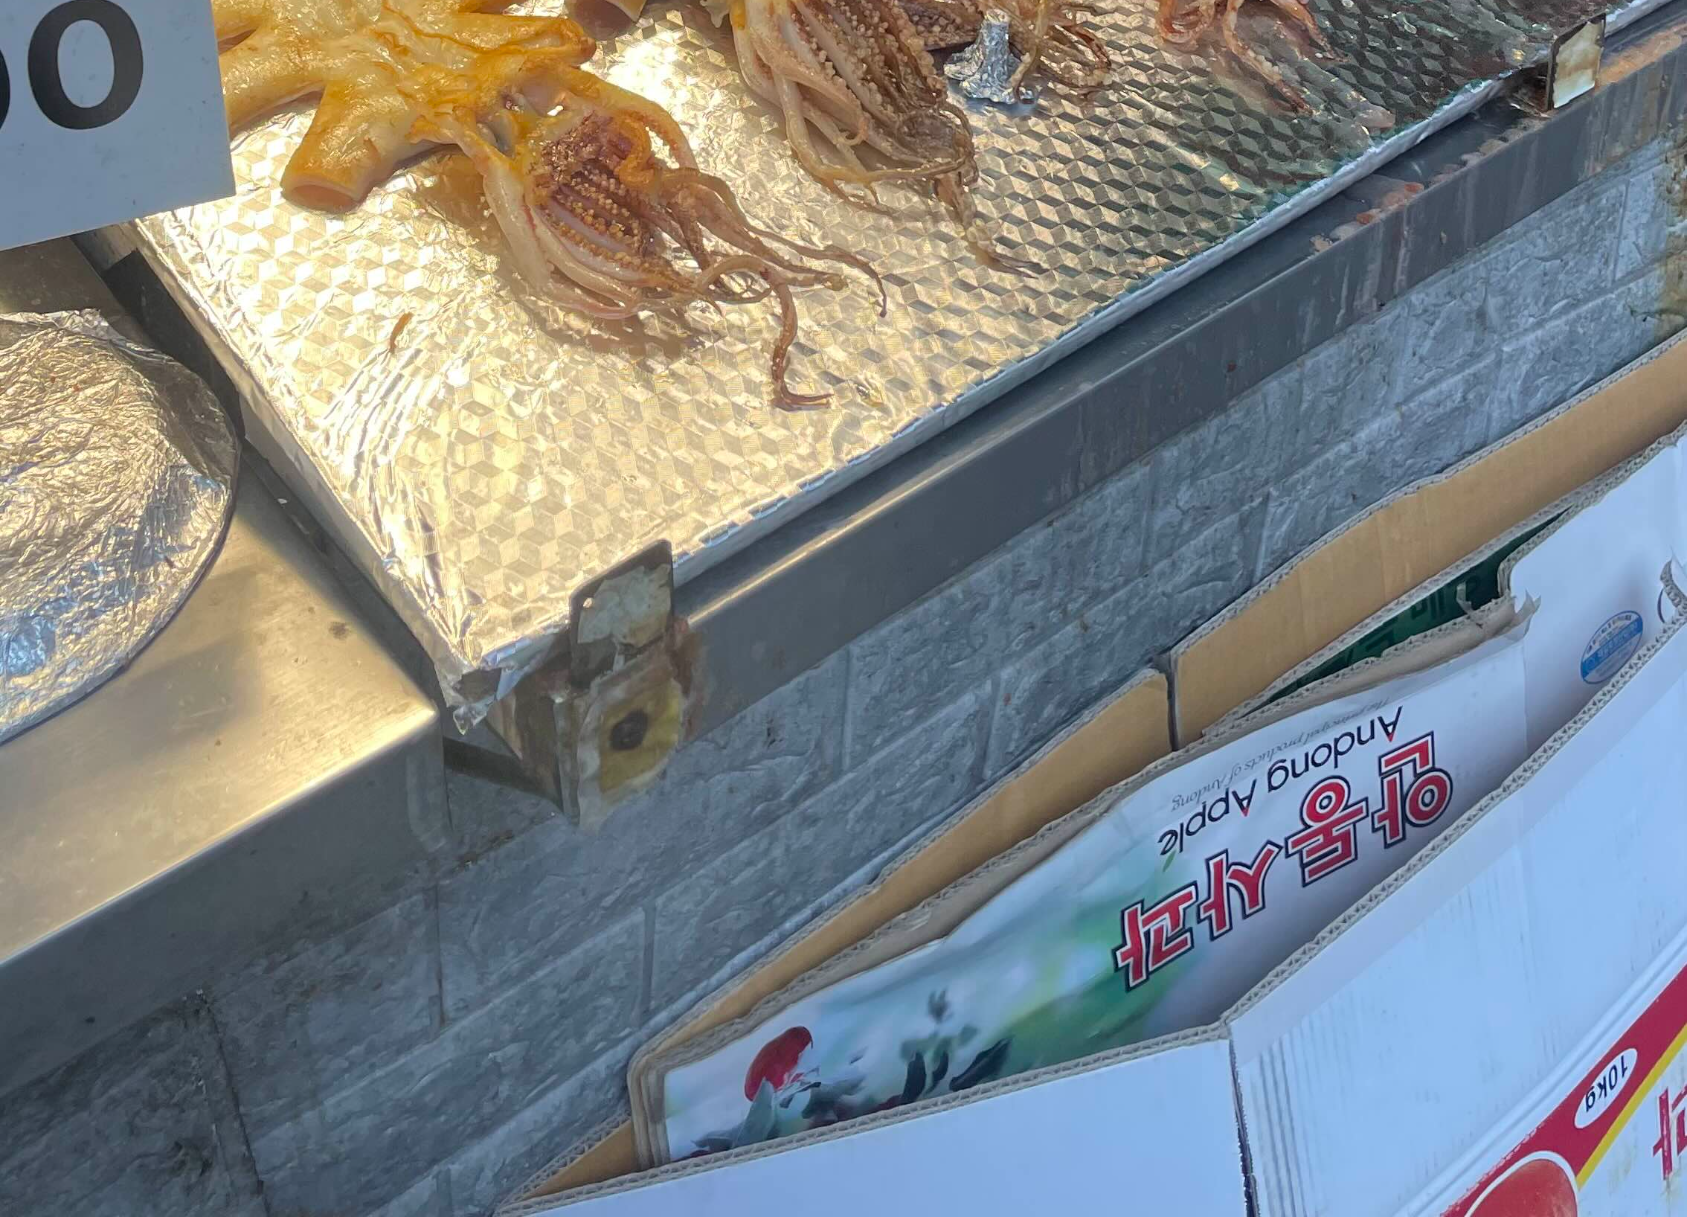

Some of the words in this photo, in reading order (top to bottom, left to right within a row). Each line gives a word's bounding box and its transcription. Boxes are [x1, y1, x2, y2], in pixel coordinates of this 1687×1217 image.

[1245, 733, 1305, 770] products
[1268, 705, 1403, 793] Andong
[1157, 779, 1257, 857] Apple
[1171, 773, 1228, 811] Andong
[1112, 730, 1454, 993] 안동사과
[1584, 1054, 1629, 1113] 10kg
